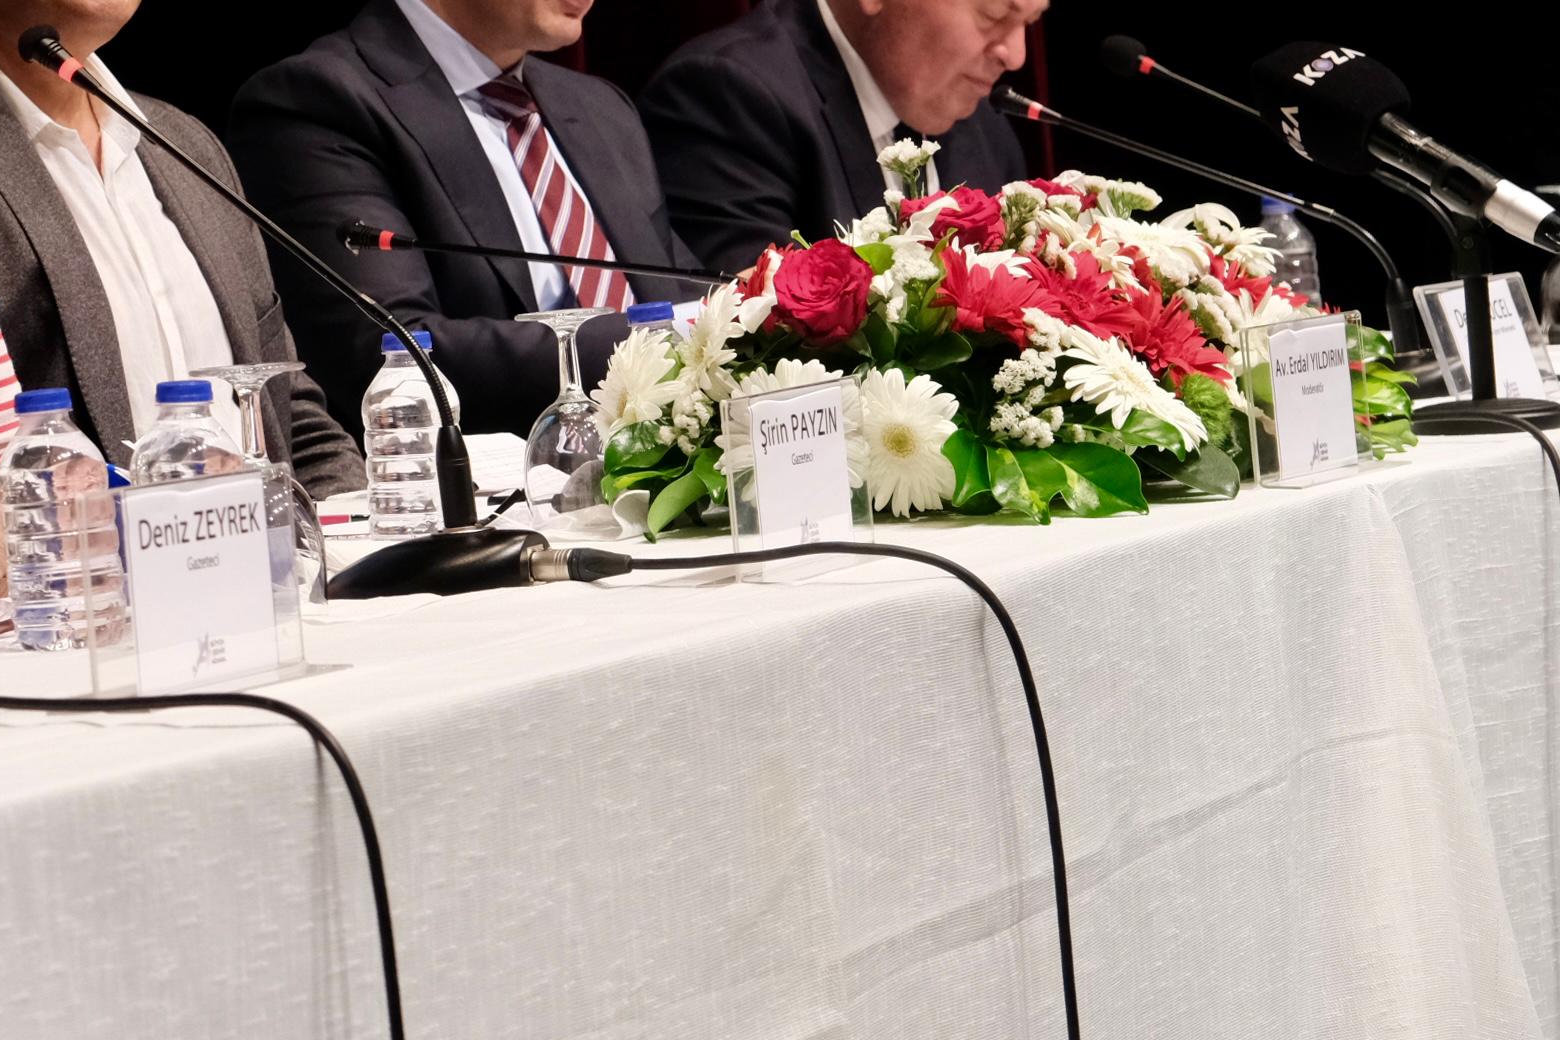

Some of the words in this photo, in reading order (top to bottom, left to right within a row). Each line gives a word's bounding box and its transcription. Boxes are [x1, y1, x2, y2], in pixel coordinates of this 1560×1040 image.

[1293, 47, 1366, 87] KOZA
[1276, 359, 1289, 377] Av.
[1290, 353, 1309, 375] Erdal
[760, 416, 789, 455] Şirin
[791, 406, 838, 442] PAYZIN
[138, 514, 190, 550] Deniz
[193, 501, 261, 541] ZEYREK
[186, 553, 220, 571] Gazeteci
